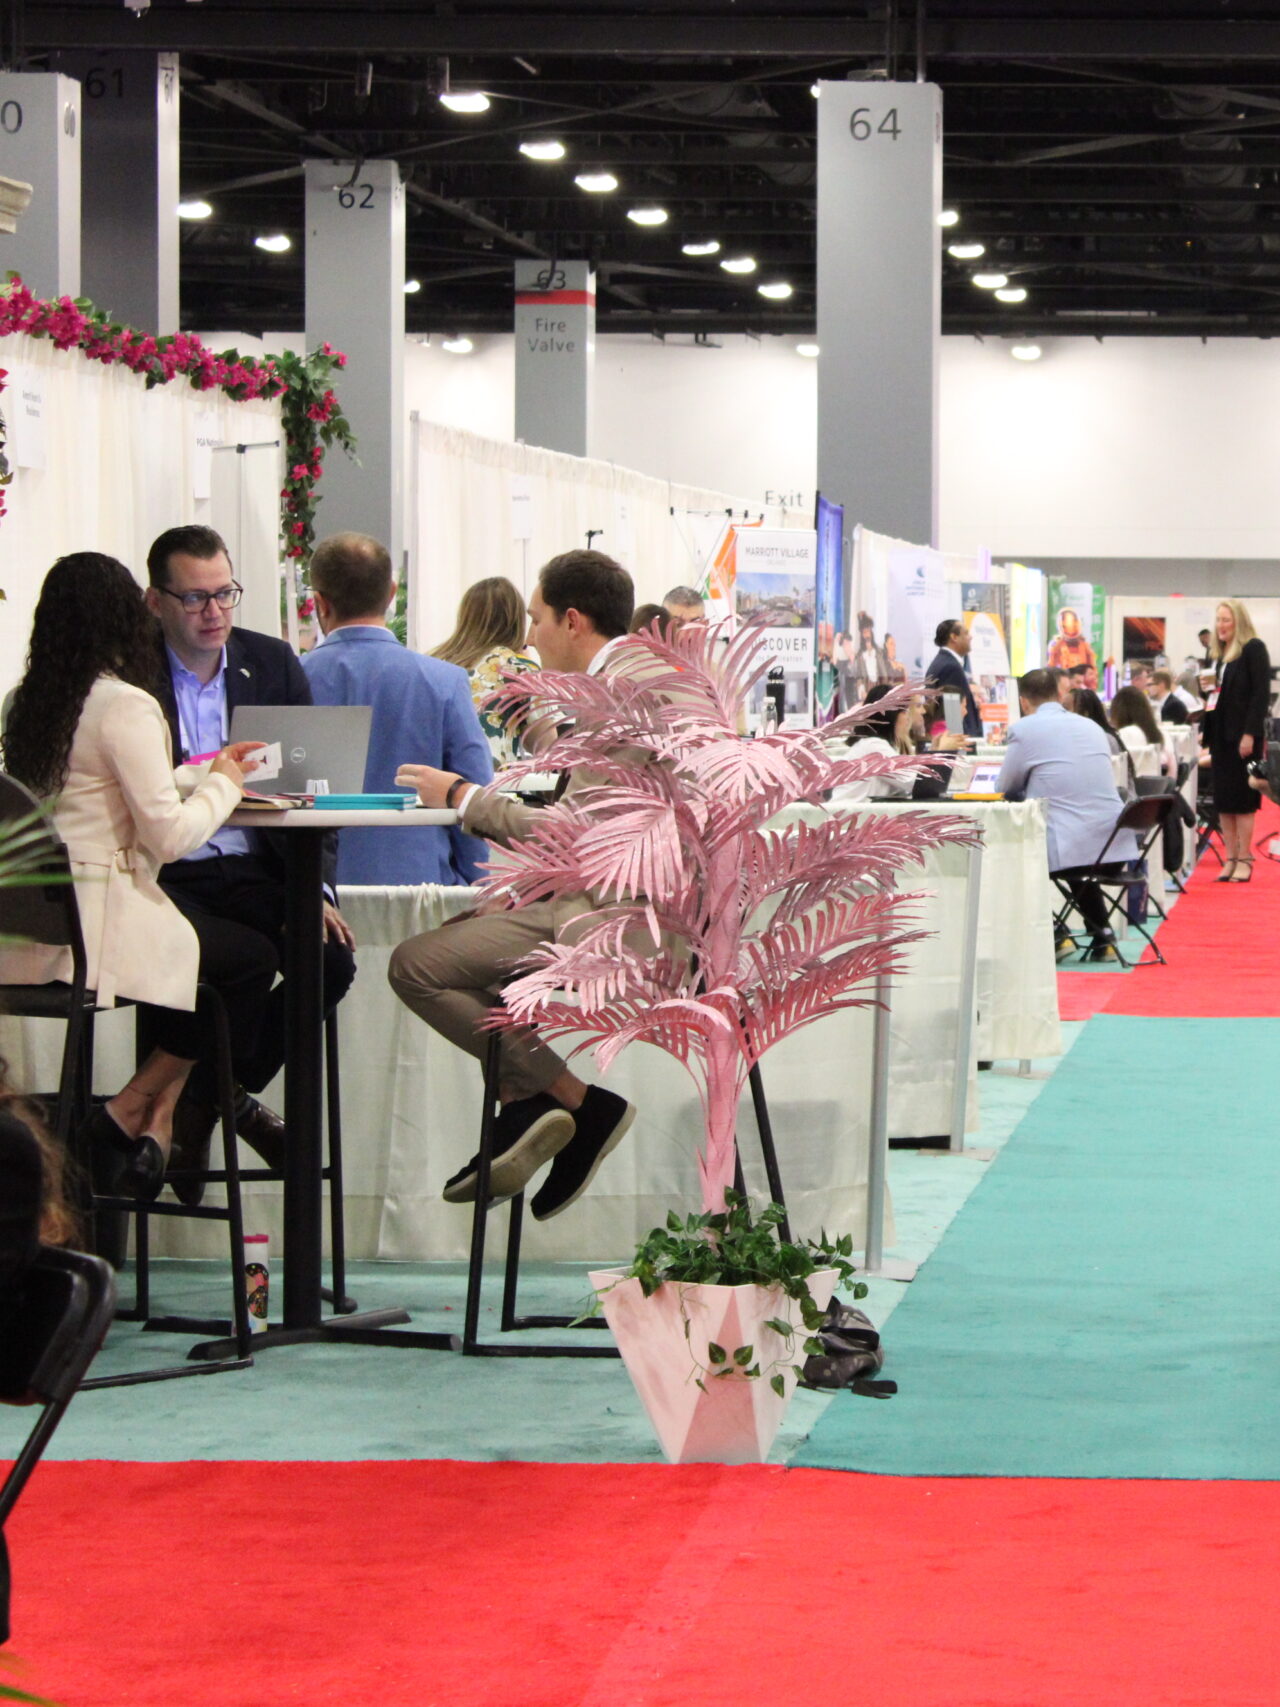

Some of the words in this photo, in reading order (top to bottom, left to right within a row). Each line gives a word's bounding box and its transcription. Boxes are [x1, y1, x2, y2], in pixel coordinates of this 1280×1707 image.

[86, 67, 124, 98] 61
[1, 100, 23, 134] 0
[849, 107, 902, 141] 64
[338, 183, 375, 209] 62
[536, 269, 567, 290] 63
[535, 318, 567, 332] Fire
[528, 337, 576, 353] Valve
[765, 490, 804, 507] Exit
[781, 548, 809, 559] VILLAGE
